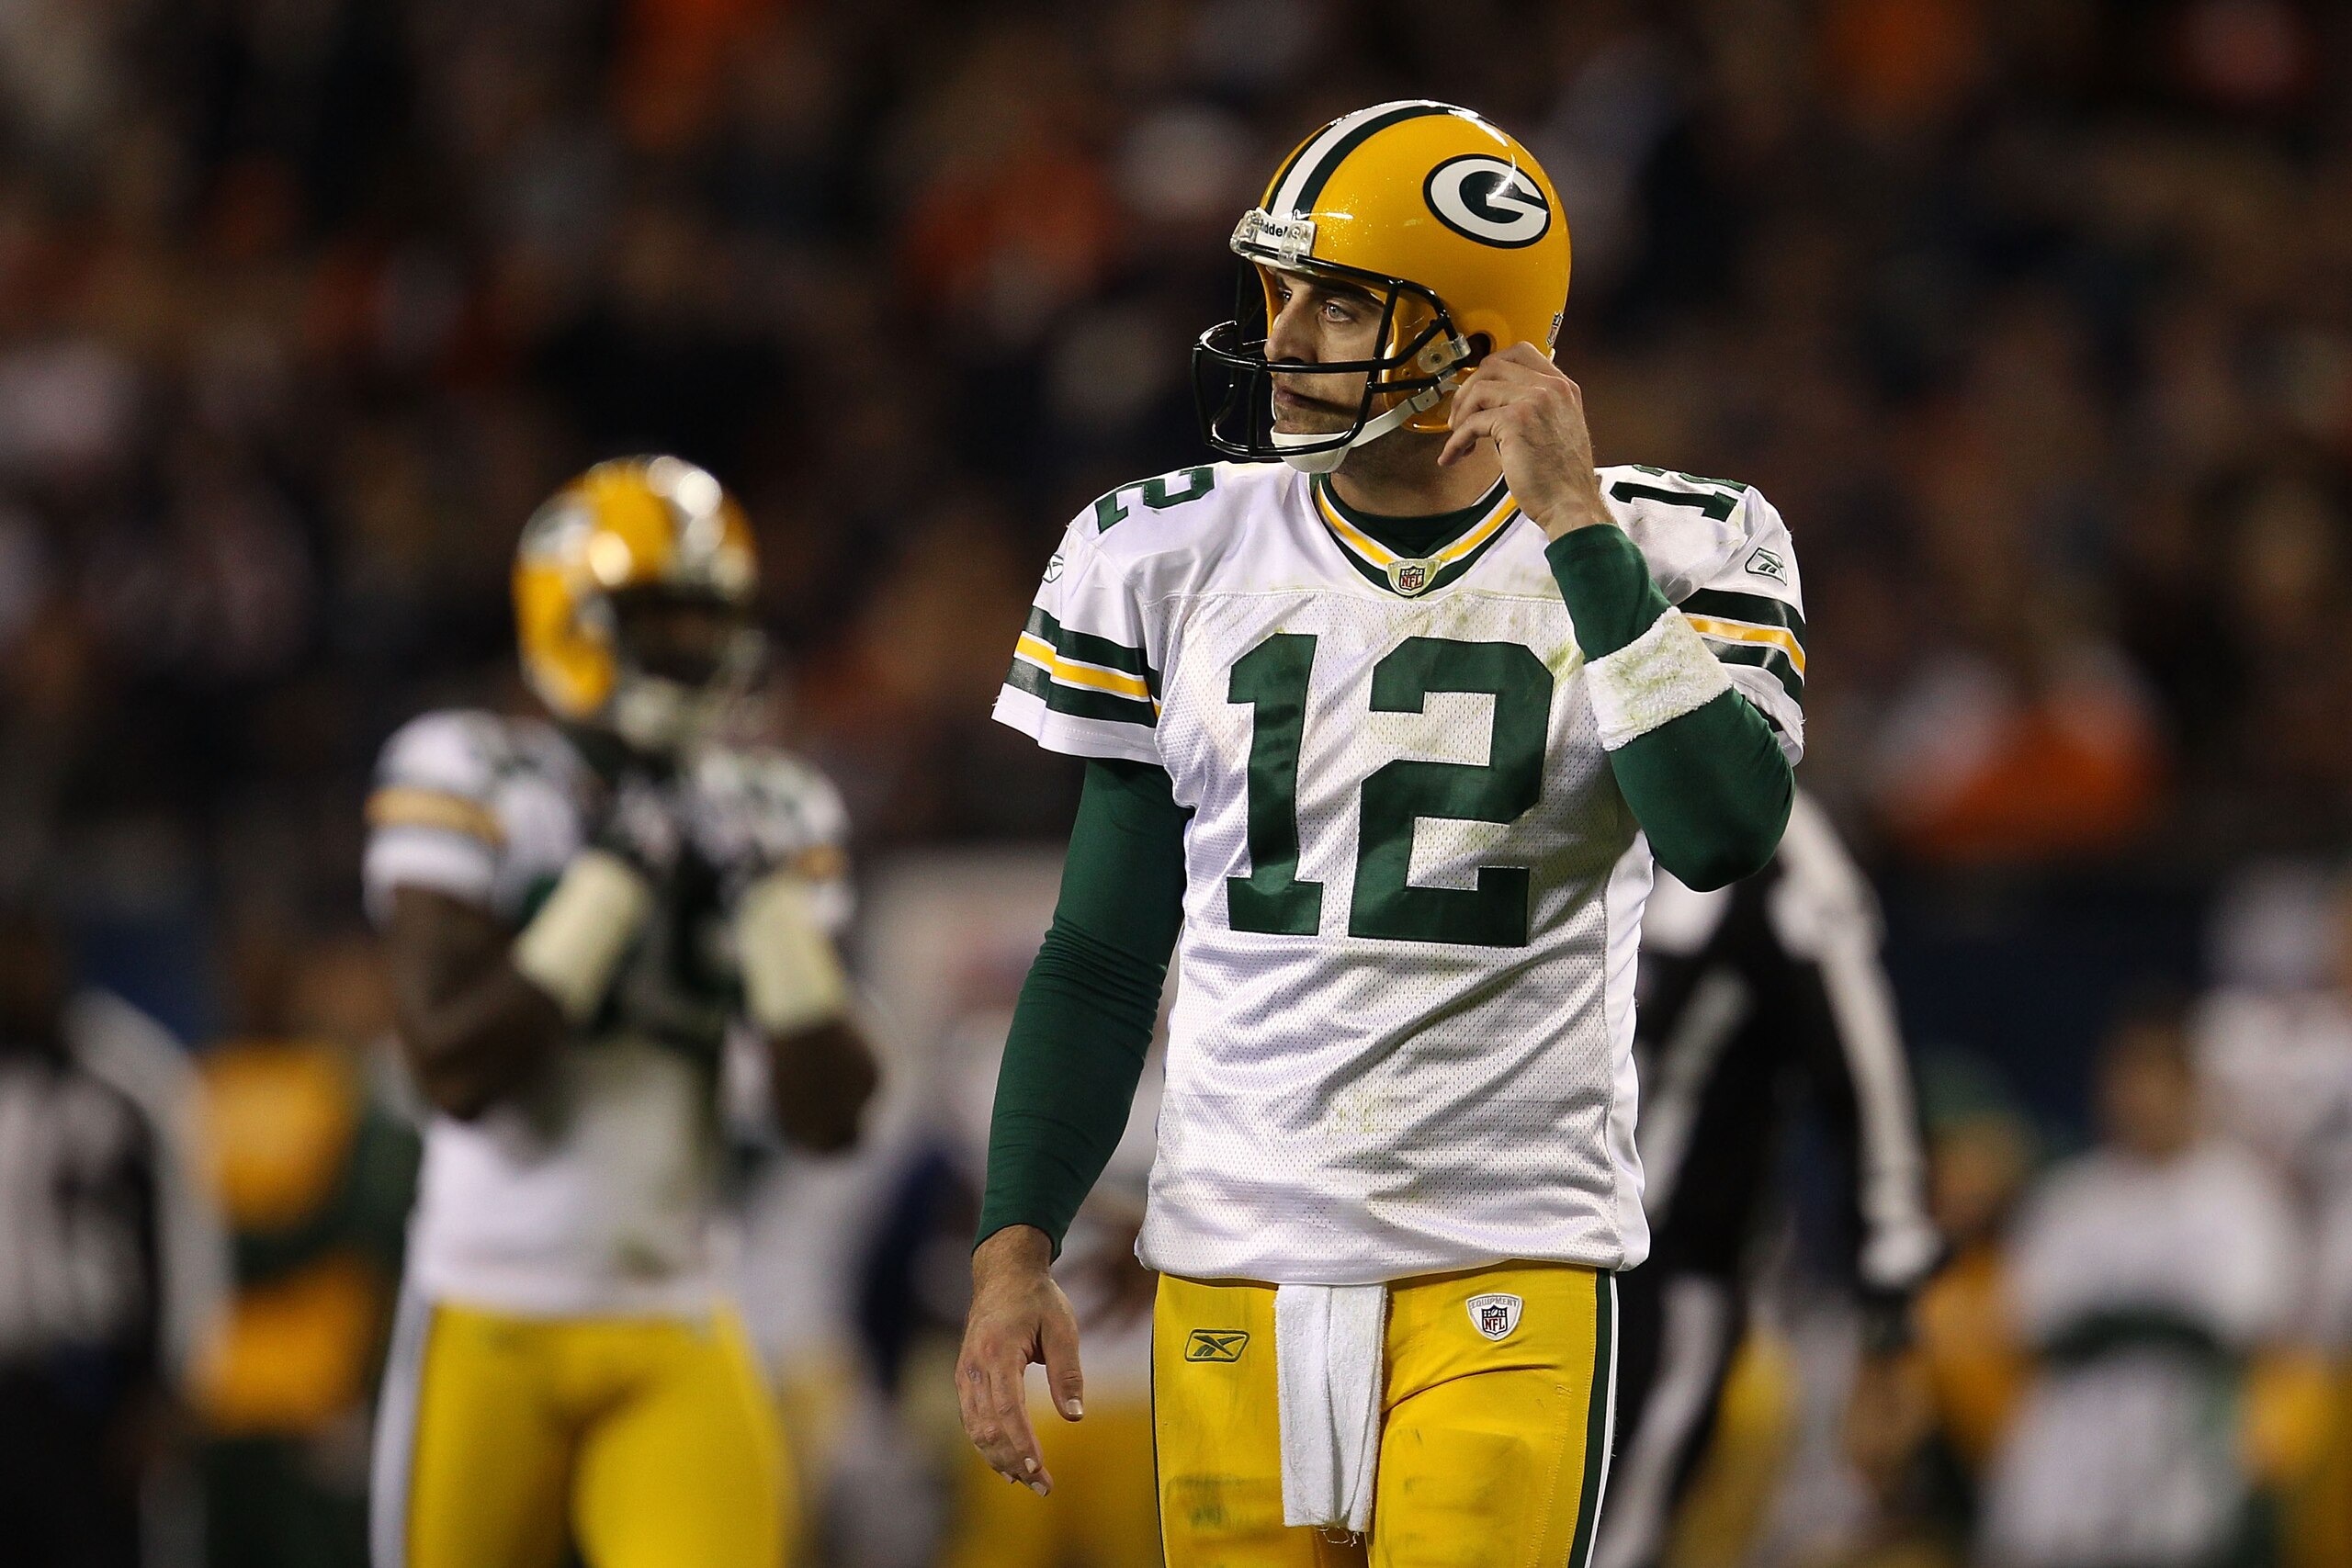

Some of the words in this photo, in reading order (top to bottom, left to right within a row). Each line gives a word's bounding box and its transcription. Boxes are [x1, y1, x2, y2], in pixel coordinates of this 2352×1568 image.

[1430, 157, 1548, 243] G
[1401, 575, 1422, 588] NFL
[1227, 632, 1555, 948] 12
[1470, 1296, 1517, 1309] EQUIPMENT
[1484, 1317, 1505, 1331] NFL
